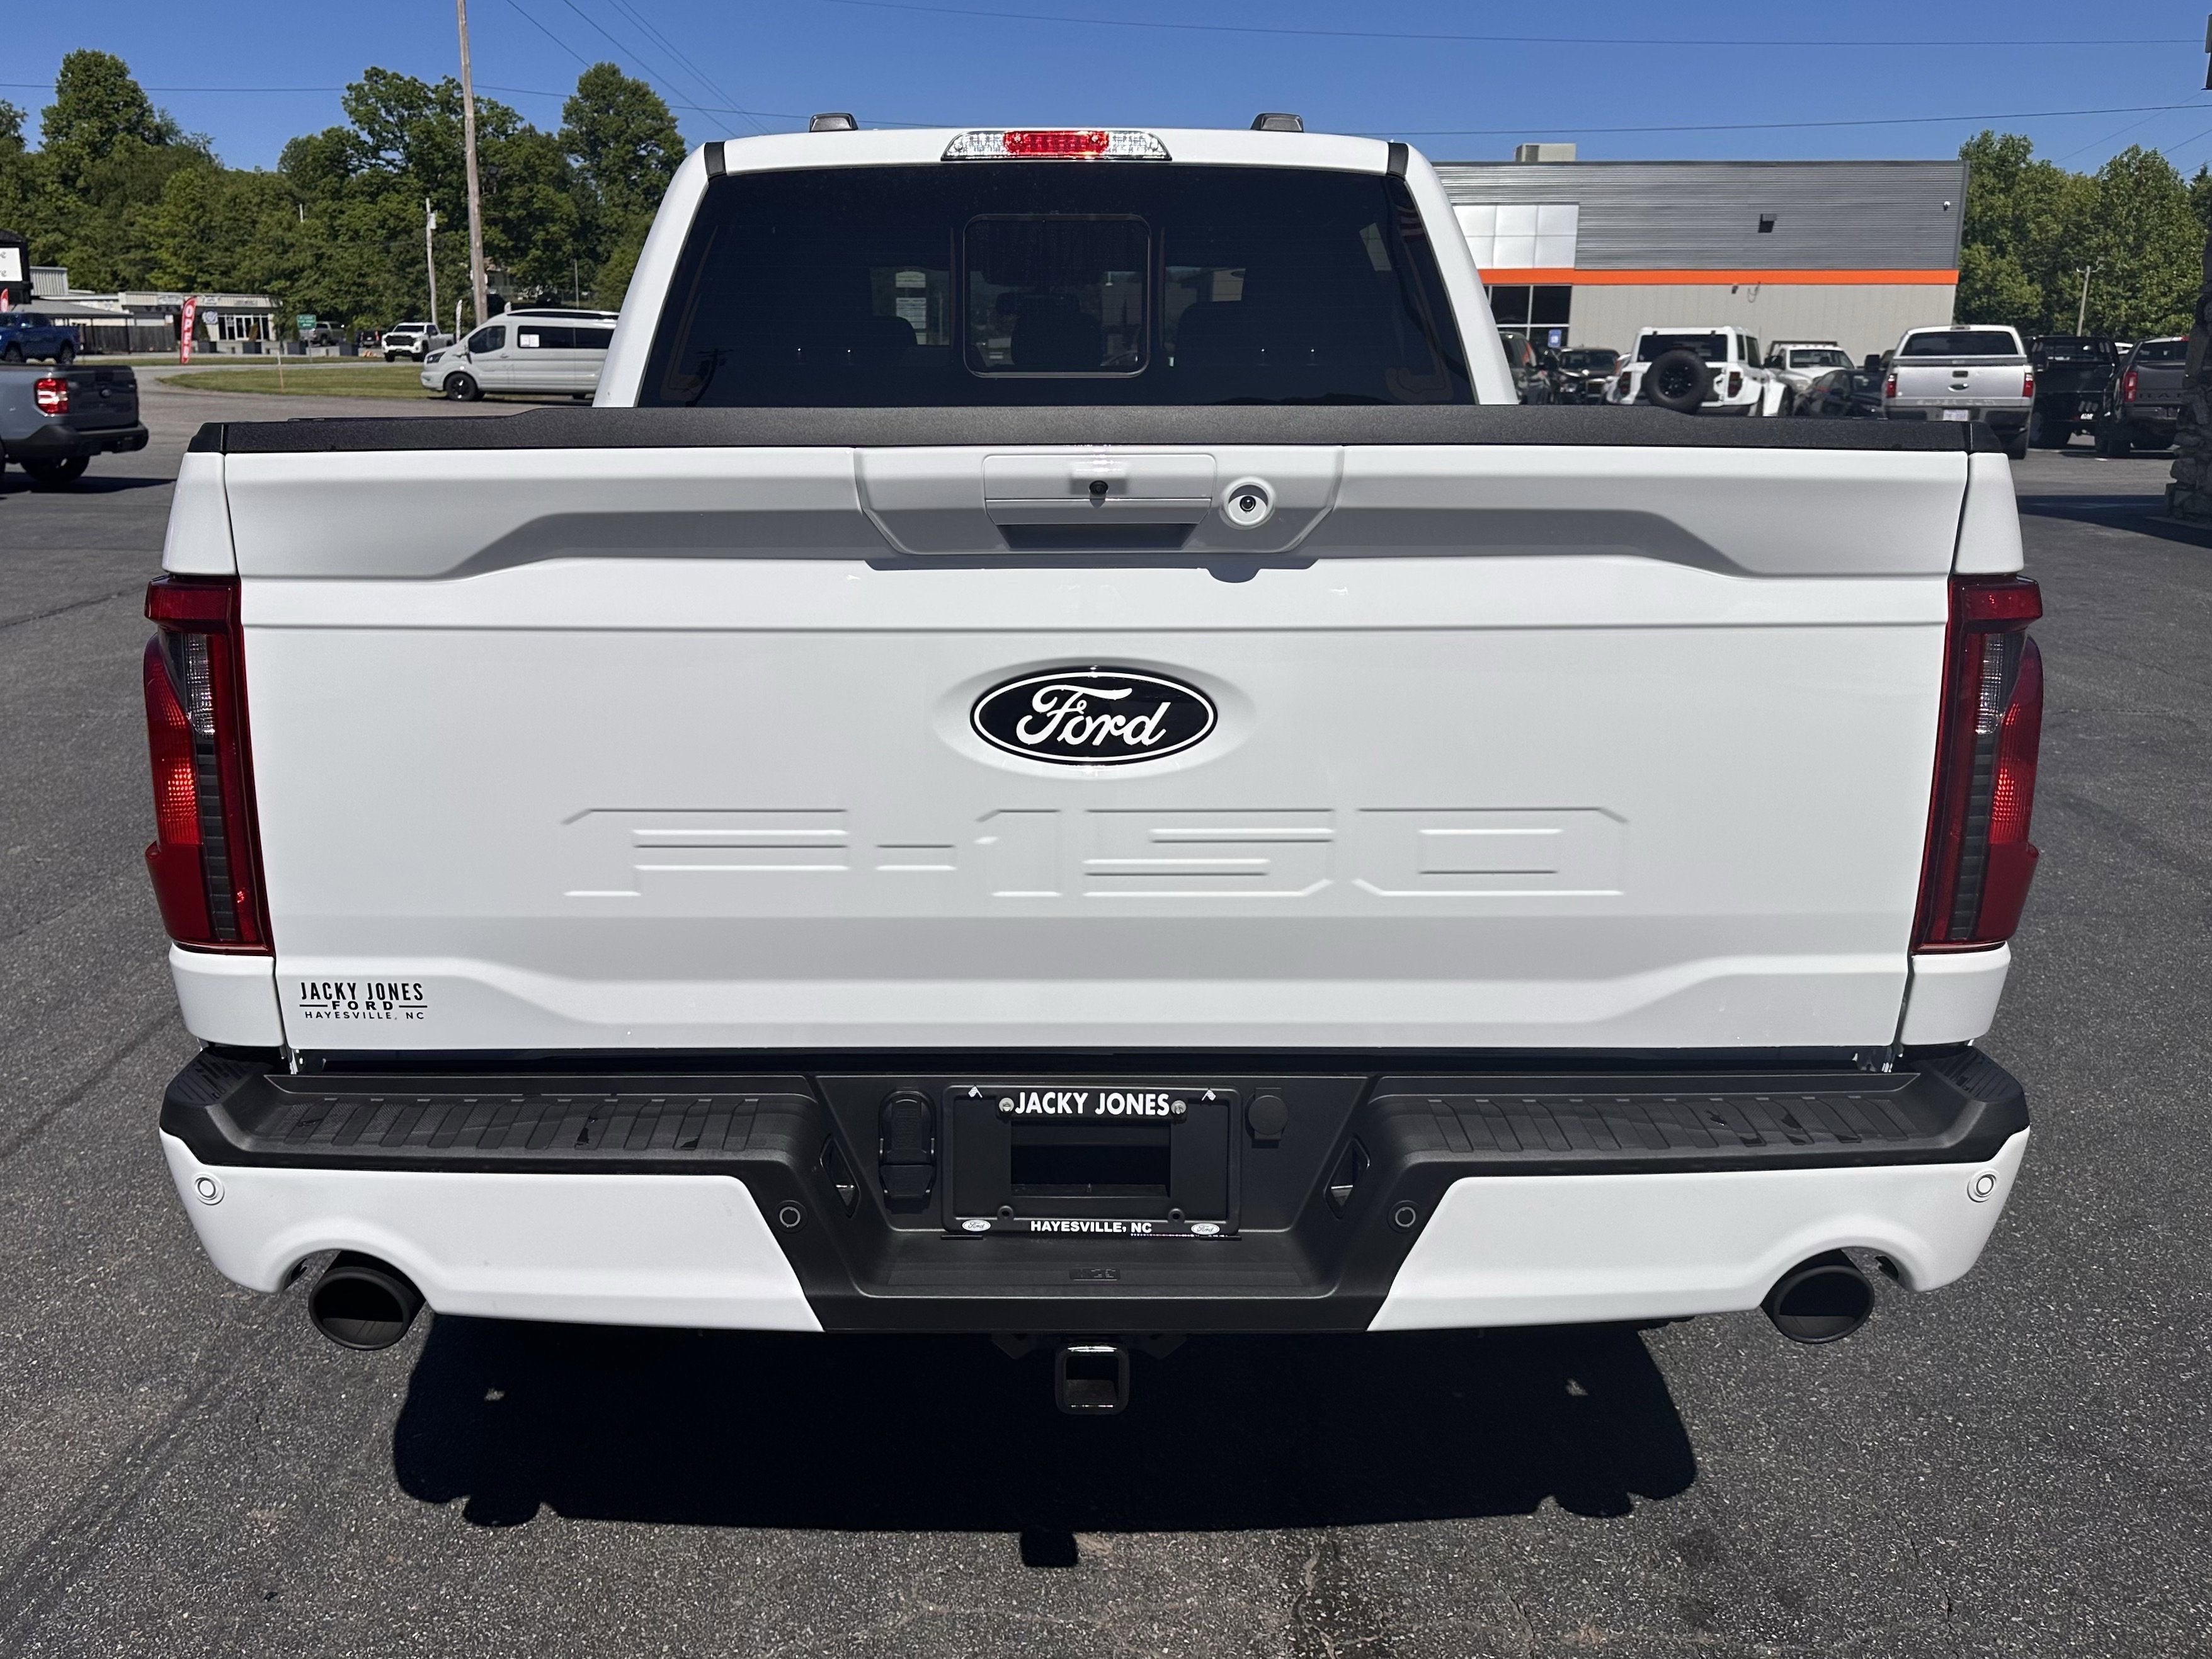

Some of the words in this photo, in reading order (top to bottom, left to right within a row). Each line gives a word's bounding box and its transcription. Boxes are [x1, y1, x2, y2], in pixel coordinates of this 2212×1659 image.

[1016, 684, 1172, 746] Ford
[562, 806, 1629, 898] F-150
[300, 982, 356, 1000] JACKY
[367, 983, 423, 1001] JONES
[331, 1000, 394, 1010] FORD
[406, 1012, 425, 1020] NC
[1015, 1092, 1088, 1114] JACKY
[1095, 1093, 1170, 1115] JONES
[1030, 1220, 1127, 1233] HAYESVILLE,
[1131, 1222, 1152, 1233] NC
